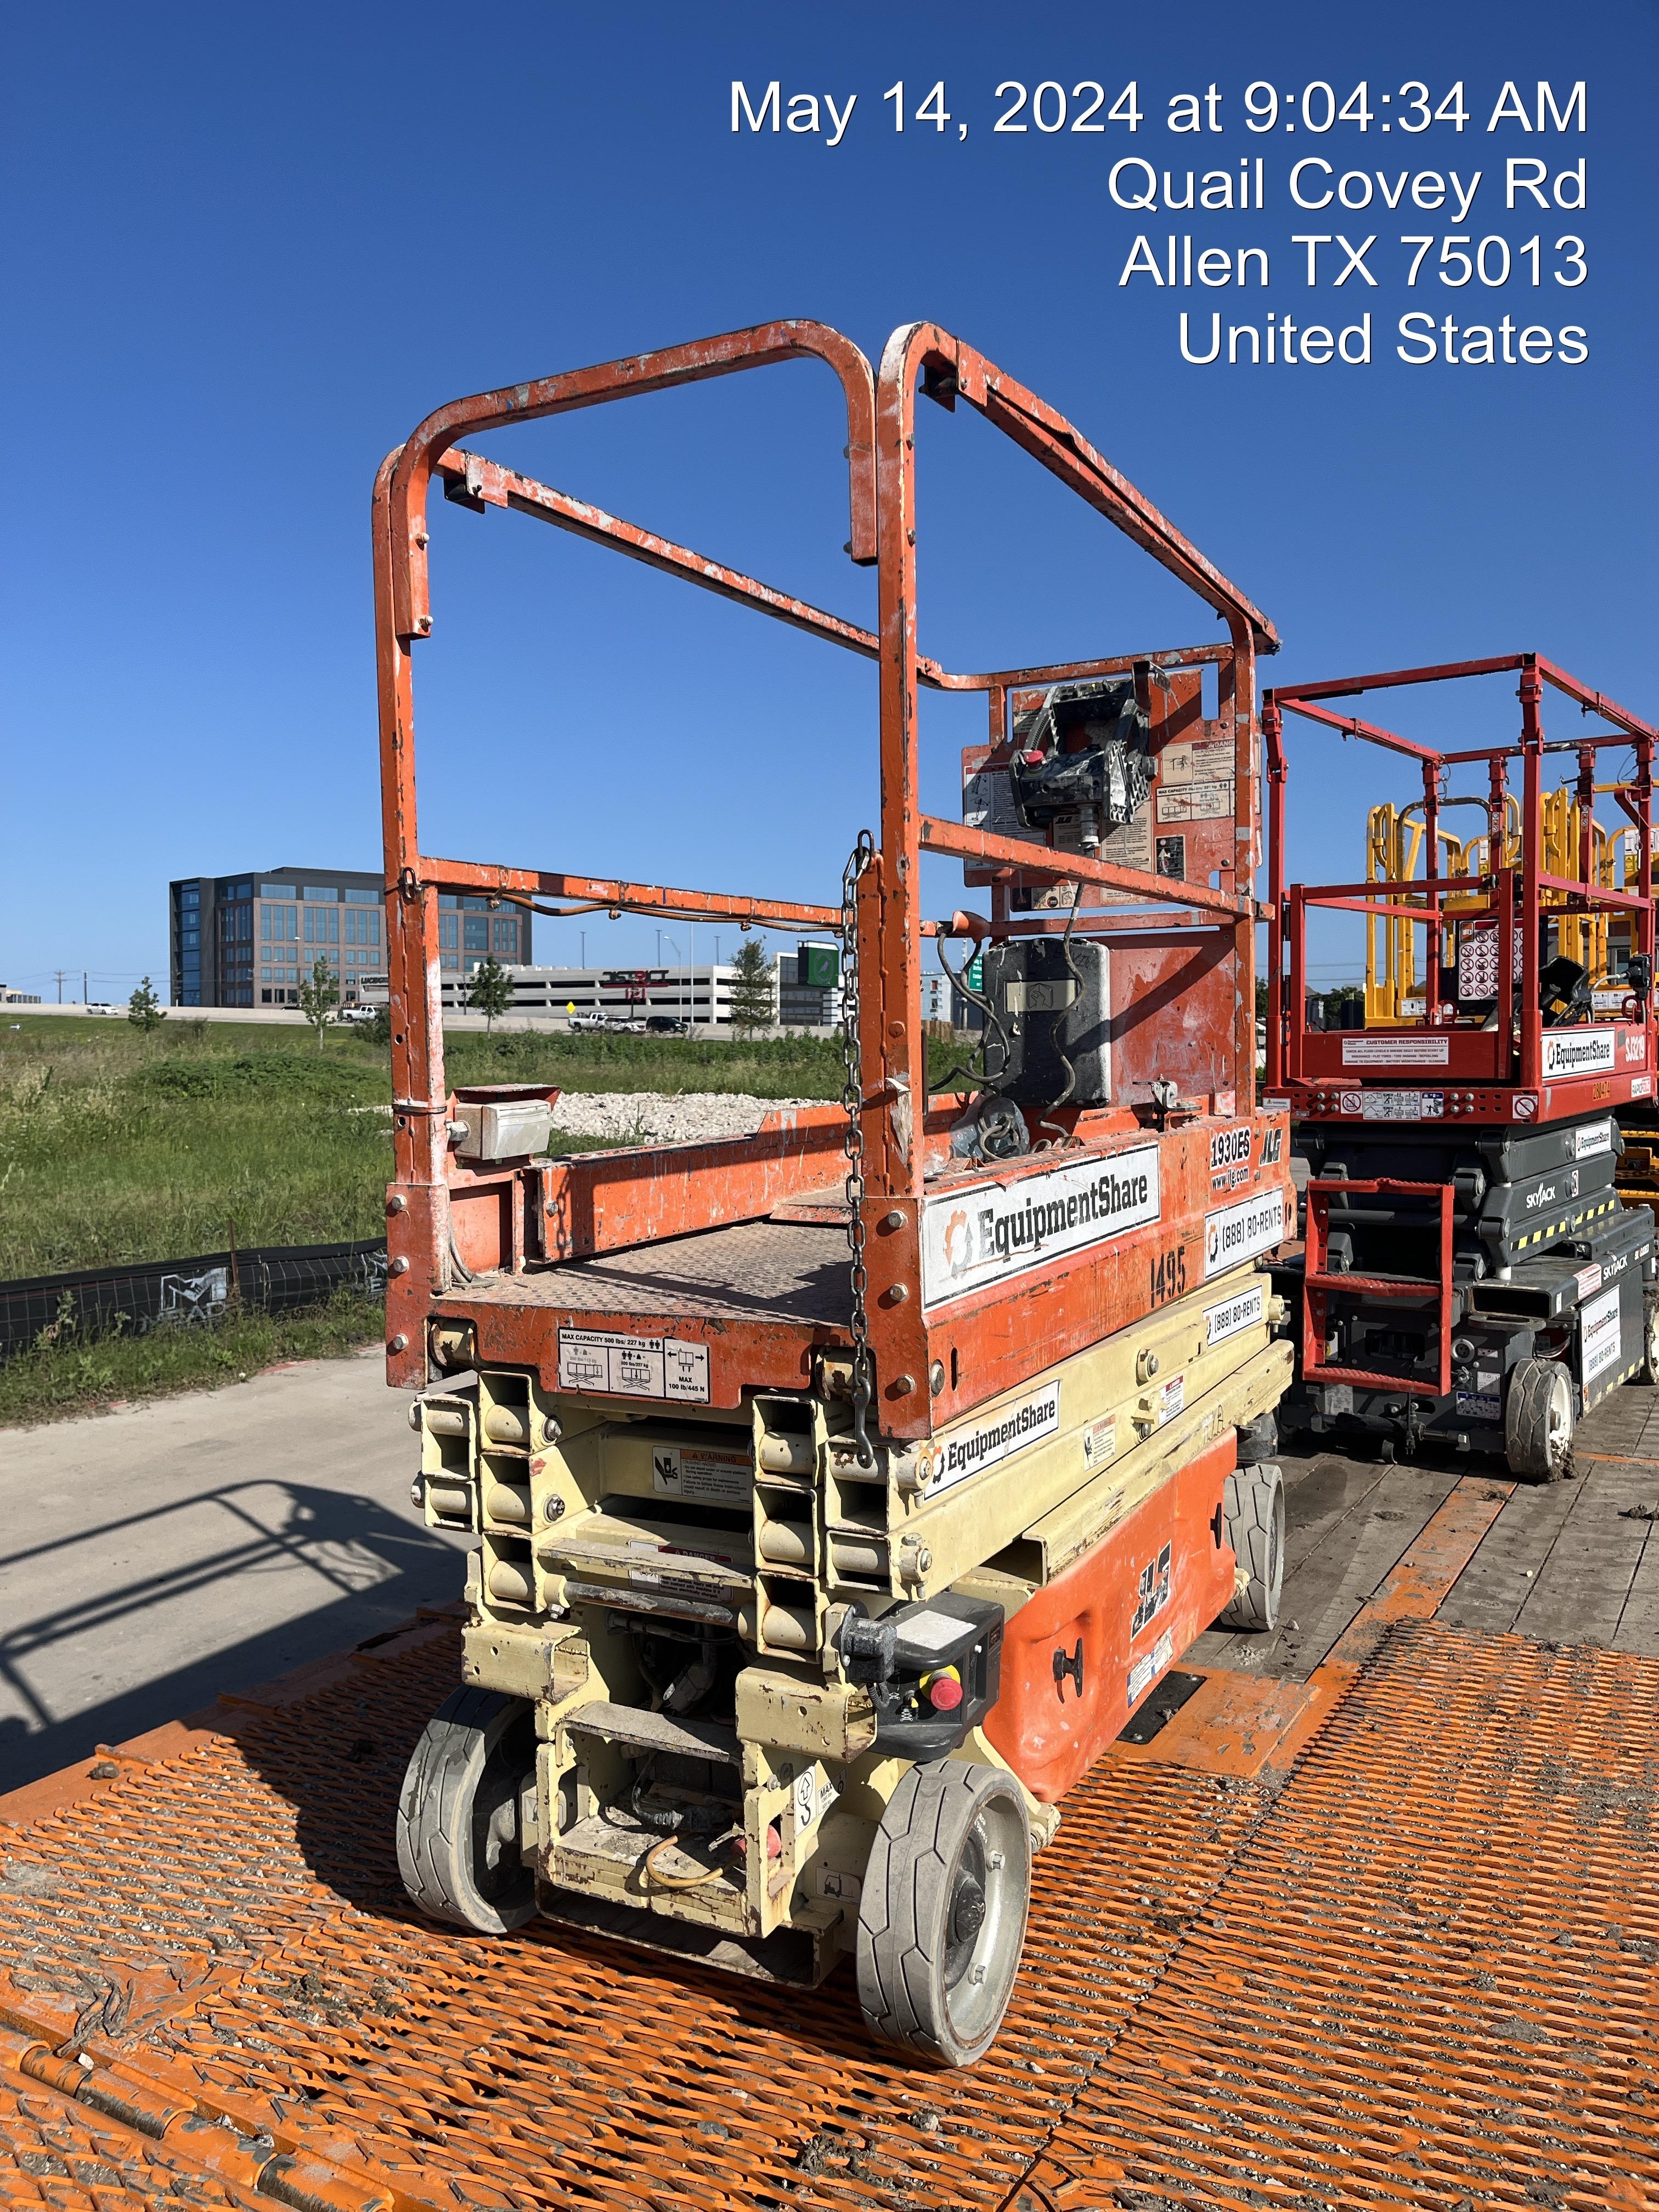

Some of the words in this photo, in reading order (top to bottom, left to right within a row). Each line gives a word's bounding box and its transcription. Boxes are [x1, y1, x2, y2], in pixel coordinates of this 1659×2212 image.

[1556, 1040, 1610, 1069] EquipmentShare
[1625, 1035, 1645, 1062] SJ3219
[1211, 1128, 1250, 1167] 1930ES
[1260, 1128, 1282, 1166] JLG
[1526, 1182, 1556, 1208] SKYJACK
[977, 1173, 1148, 1263] EquipmentShare
[1222, 1218, 1245, 1252] (888)
[1247, 1205, 1282, 1238] 80-RENTS
[1150, 1245, 1186, 1309] 1495
[1603, 1255, 1628, 1280] SKYJACK
[1215, 1307, 1231, 1334] (888)
[1233, 1296, 1260, 1323] 80-RENTS
[1588, 1308, 1618, 1338] EquipmentShare
[575, 1335, 603, 1343] CAPACITY
[680, 1384, 698, 1392] lb/445
[947, 1400, 1055, 1471] EquipmentShare
[701, 1452, 737, 1463] WARNING
[820, 1782, 833, 1799] MAX
